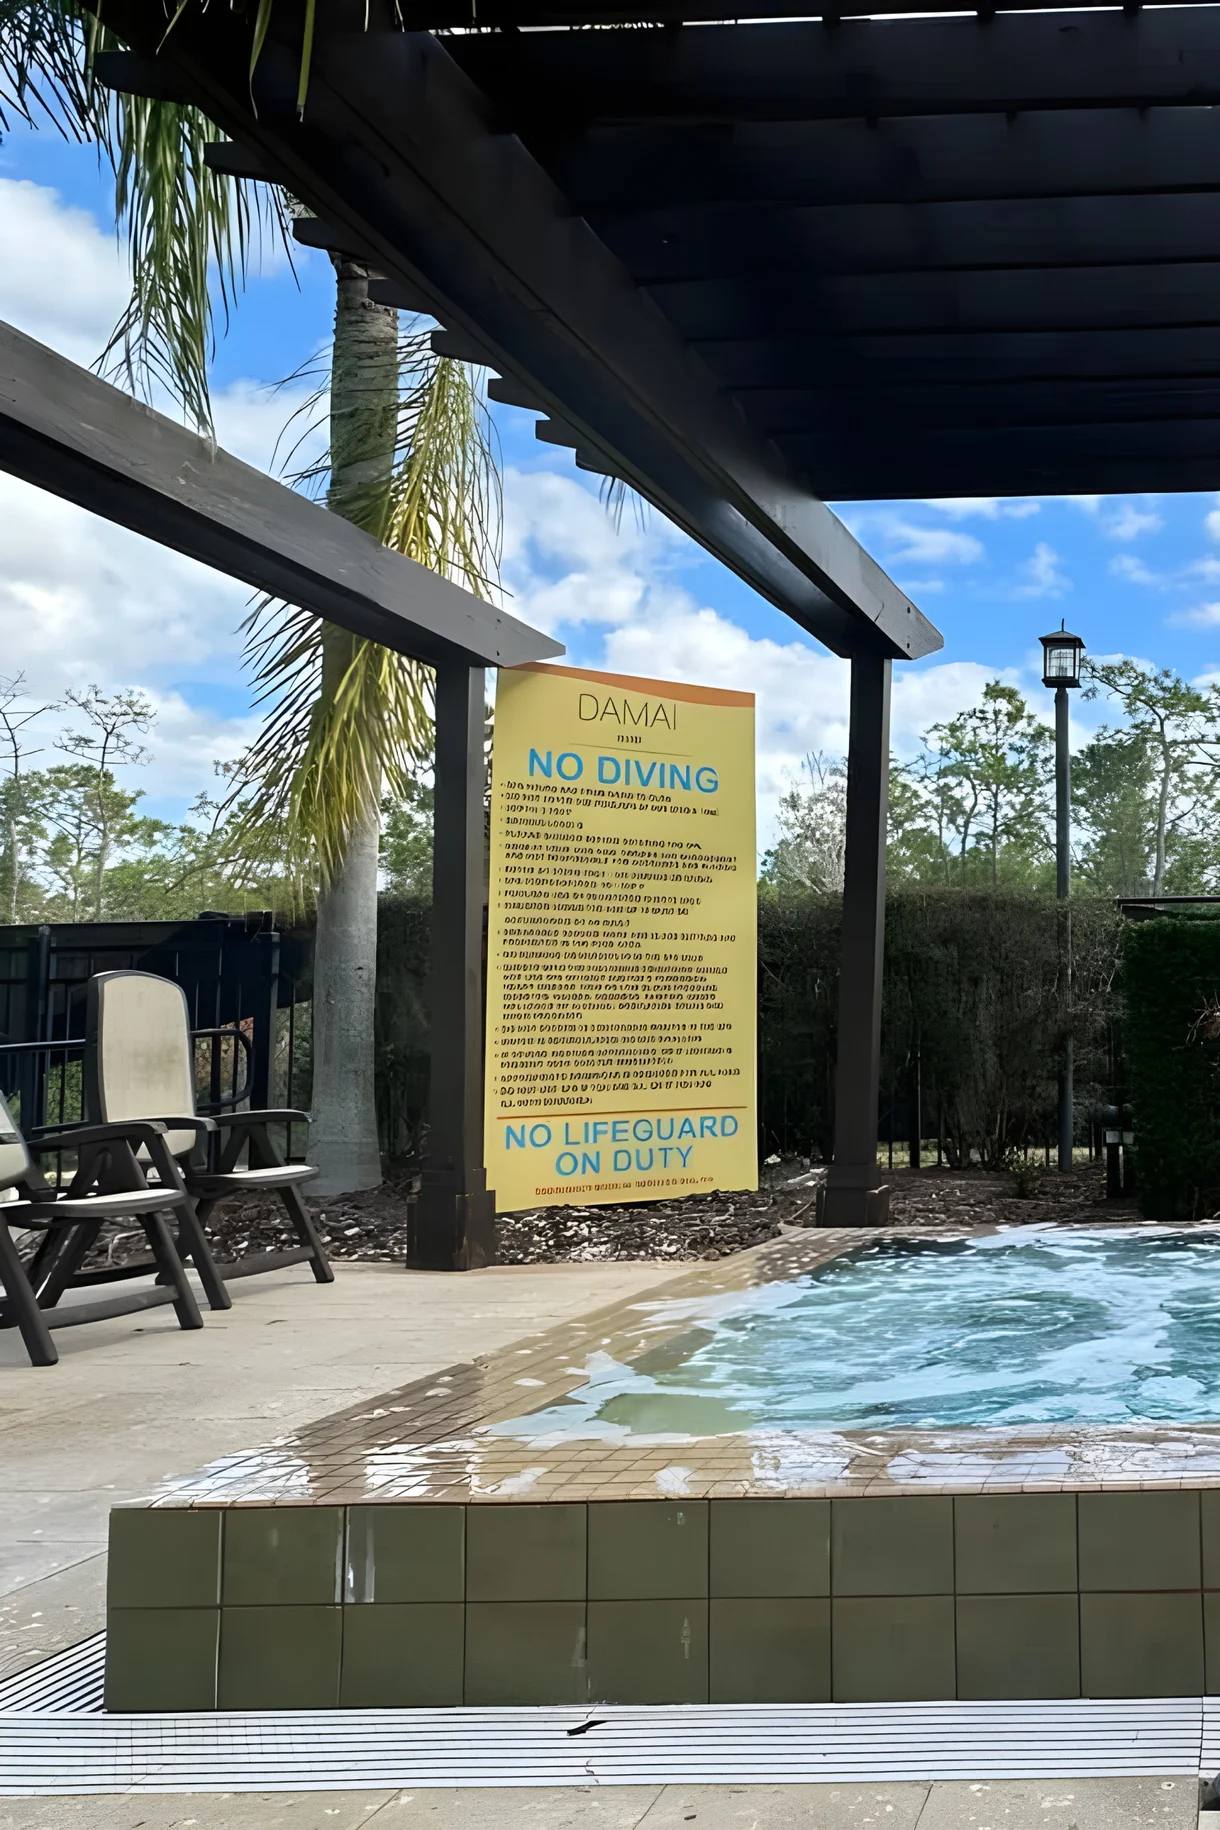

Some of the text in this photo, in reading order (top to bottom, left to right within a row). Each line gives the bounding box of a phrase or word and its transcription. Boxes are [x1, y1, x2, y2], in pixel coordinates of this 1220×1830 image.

[578, 693, 677, 730] DAMAI
[529, 748, 584, 781] NO
[597, 756, 719, 793] DIVING
[505, 1115, 739, 1149] NO LIFEGUARD
[555, 1145, 693, 1176] ON DUTY
